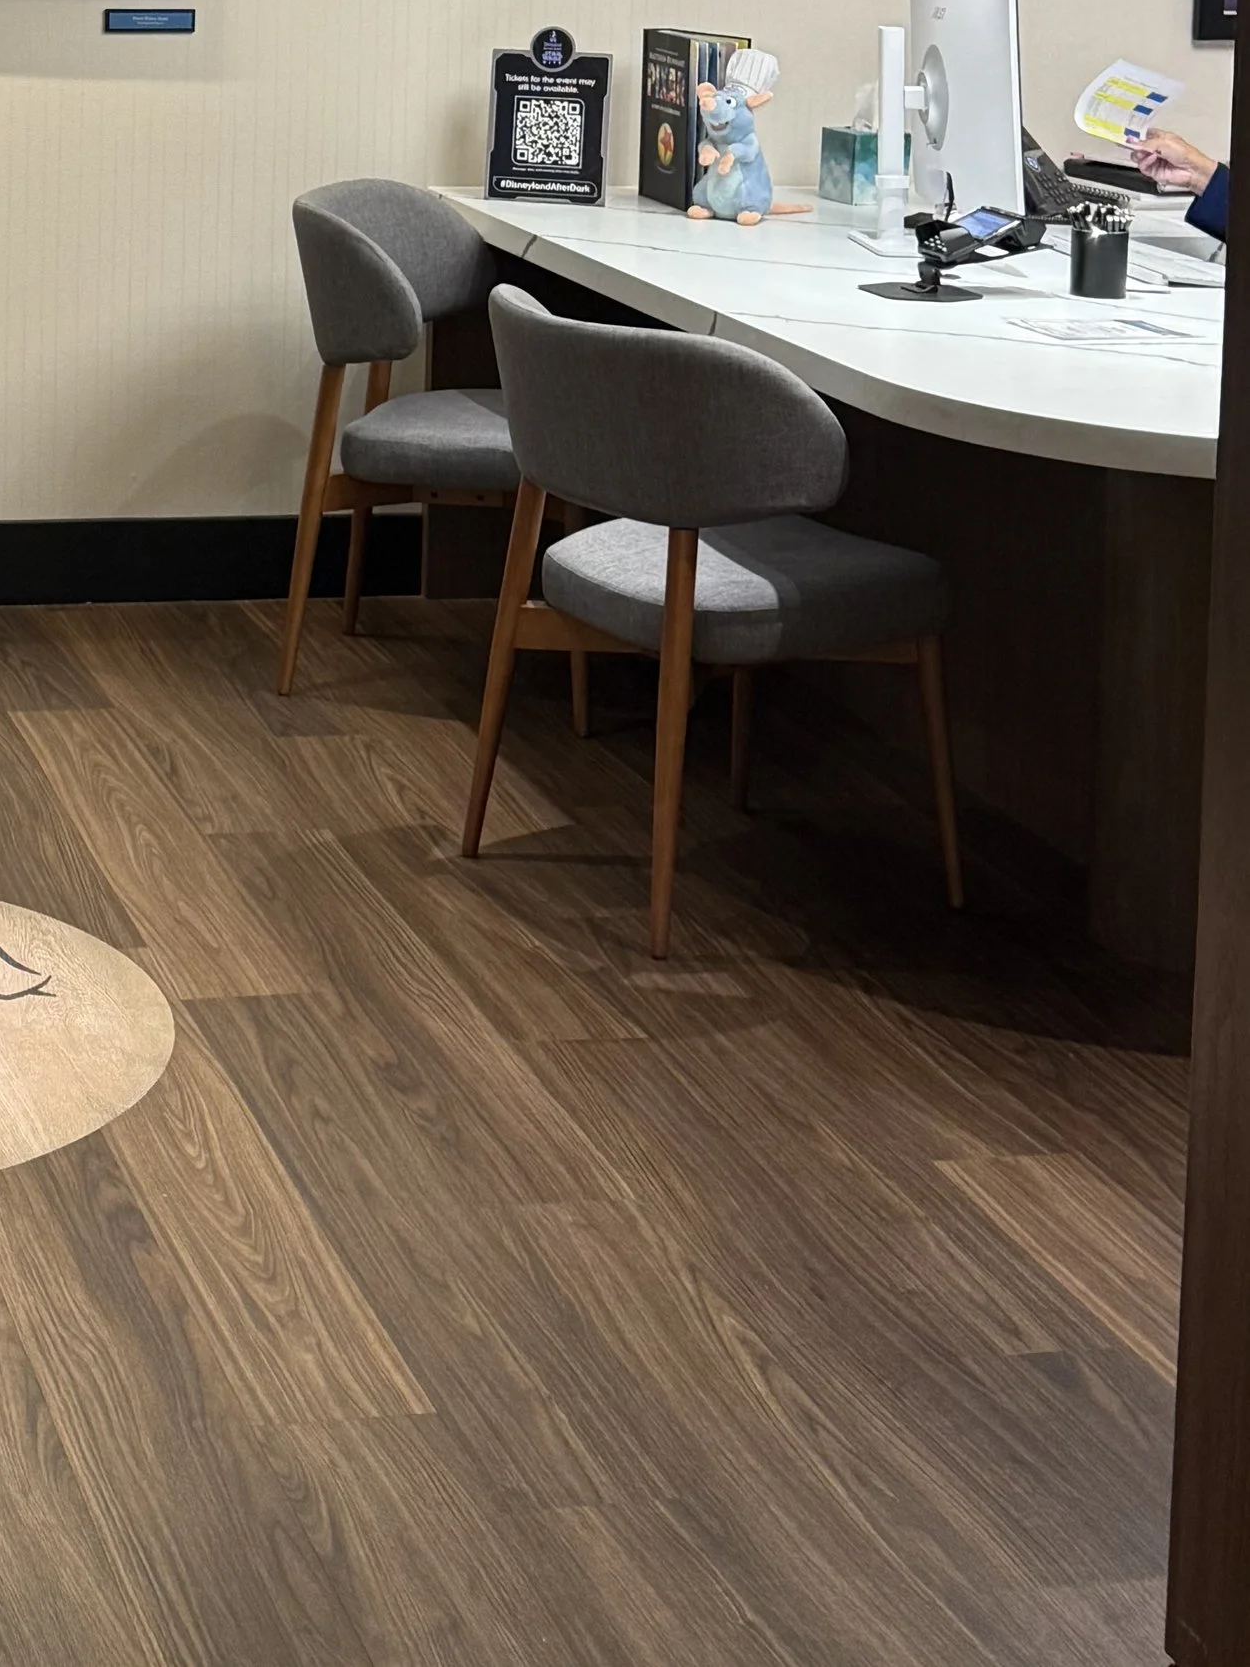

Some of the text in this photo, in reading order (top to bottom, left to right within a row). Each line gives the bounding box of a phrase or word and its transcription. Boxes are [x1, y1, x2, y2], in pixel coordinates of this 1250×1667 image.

[505, 73, 529, 82] Tickets
[530, 75, 540, 83] for
[542, 75, 554, 84] the
[578, 78, 596, 87] may
[518, 83, 579, 93] still be available.
[500, 179, 590, 193] #DisneylandAfterDark
